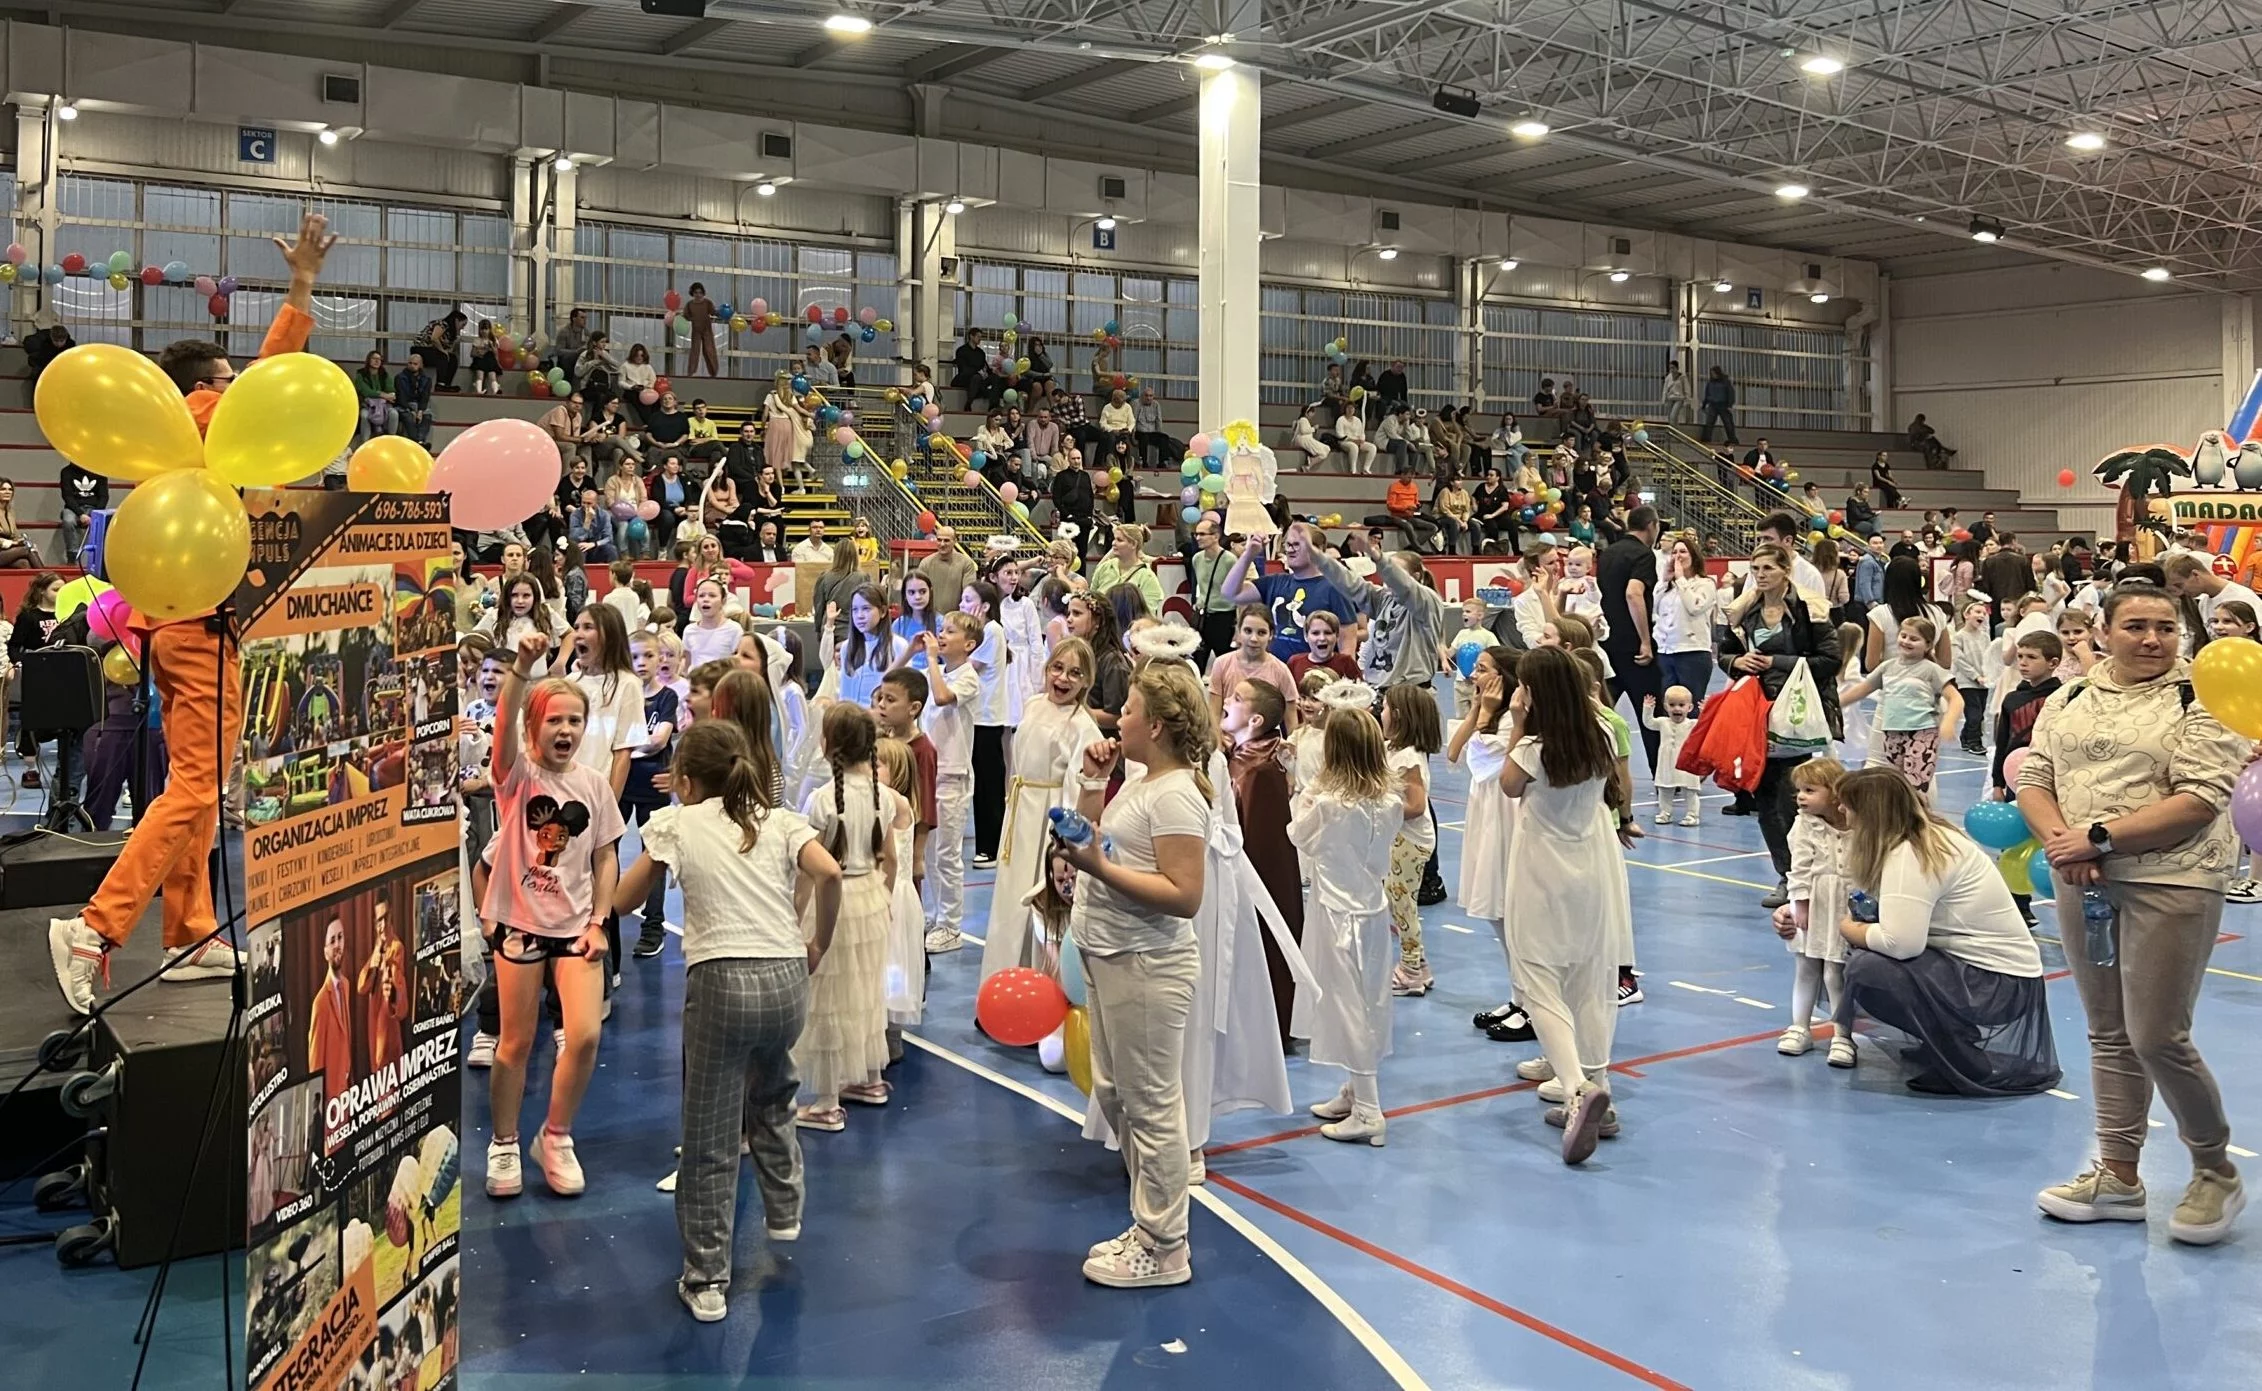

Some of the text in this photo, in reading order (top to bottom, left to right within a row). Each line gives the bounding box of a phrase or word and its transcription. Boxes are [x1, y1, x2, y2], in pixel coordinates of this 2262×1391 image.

[250, 140, 265, 160] C
[1100, 232, 1109, 246] B
[1751, 295, 1759, 307] A
[375, 501, 442, 519] 696-786-593
[2174, 501, 2262, 520] MADA
[251, 521, 299, 541] GENCJA
[339, 531, 448, 553] ANIMACJE DLA DZIECI
[286, 583, 373, 620] DMUCHAŃCE
[416, 718, 450, 738] POPCORN
[252, 796, 389, 861] ORGANIZACJA IMPREZ
[277, 855, 307, 880] FESTYNY
[248, 992, 282, 1022] OTOBUDKA
[326, 1028, 458, 1129] OPRAWA IMPREZ
[276, 1194, 313, 1223] VIDEO 360
[272, 1285, 360, 1391] TEGRACJA
